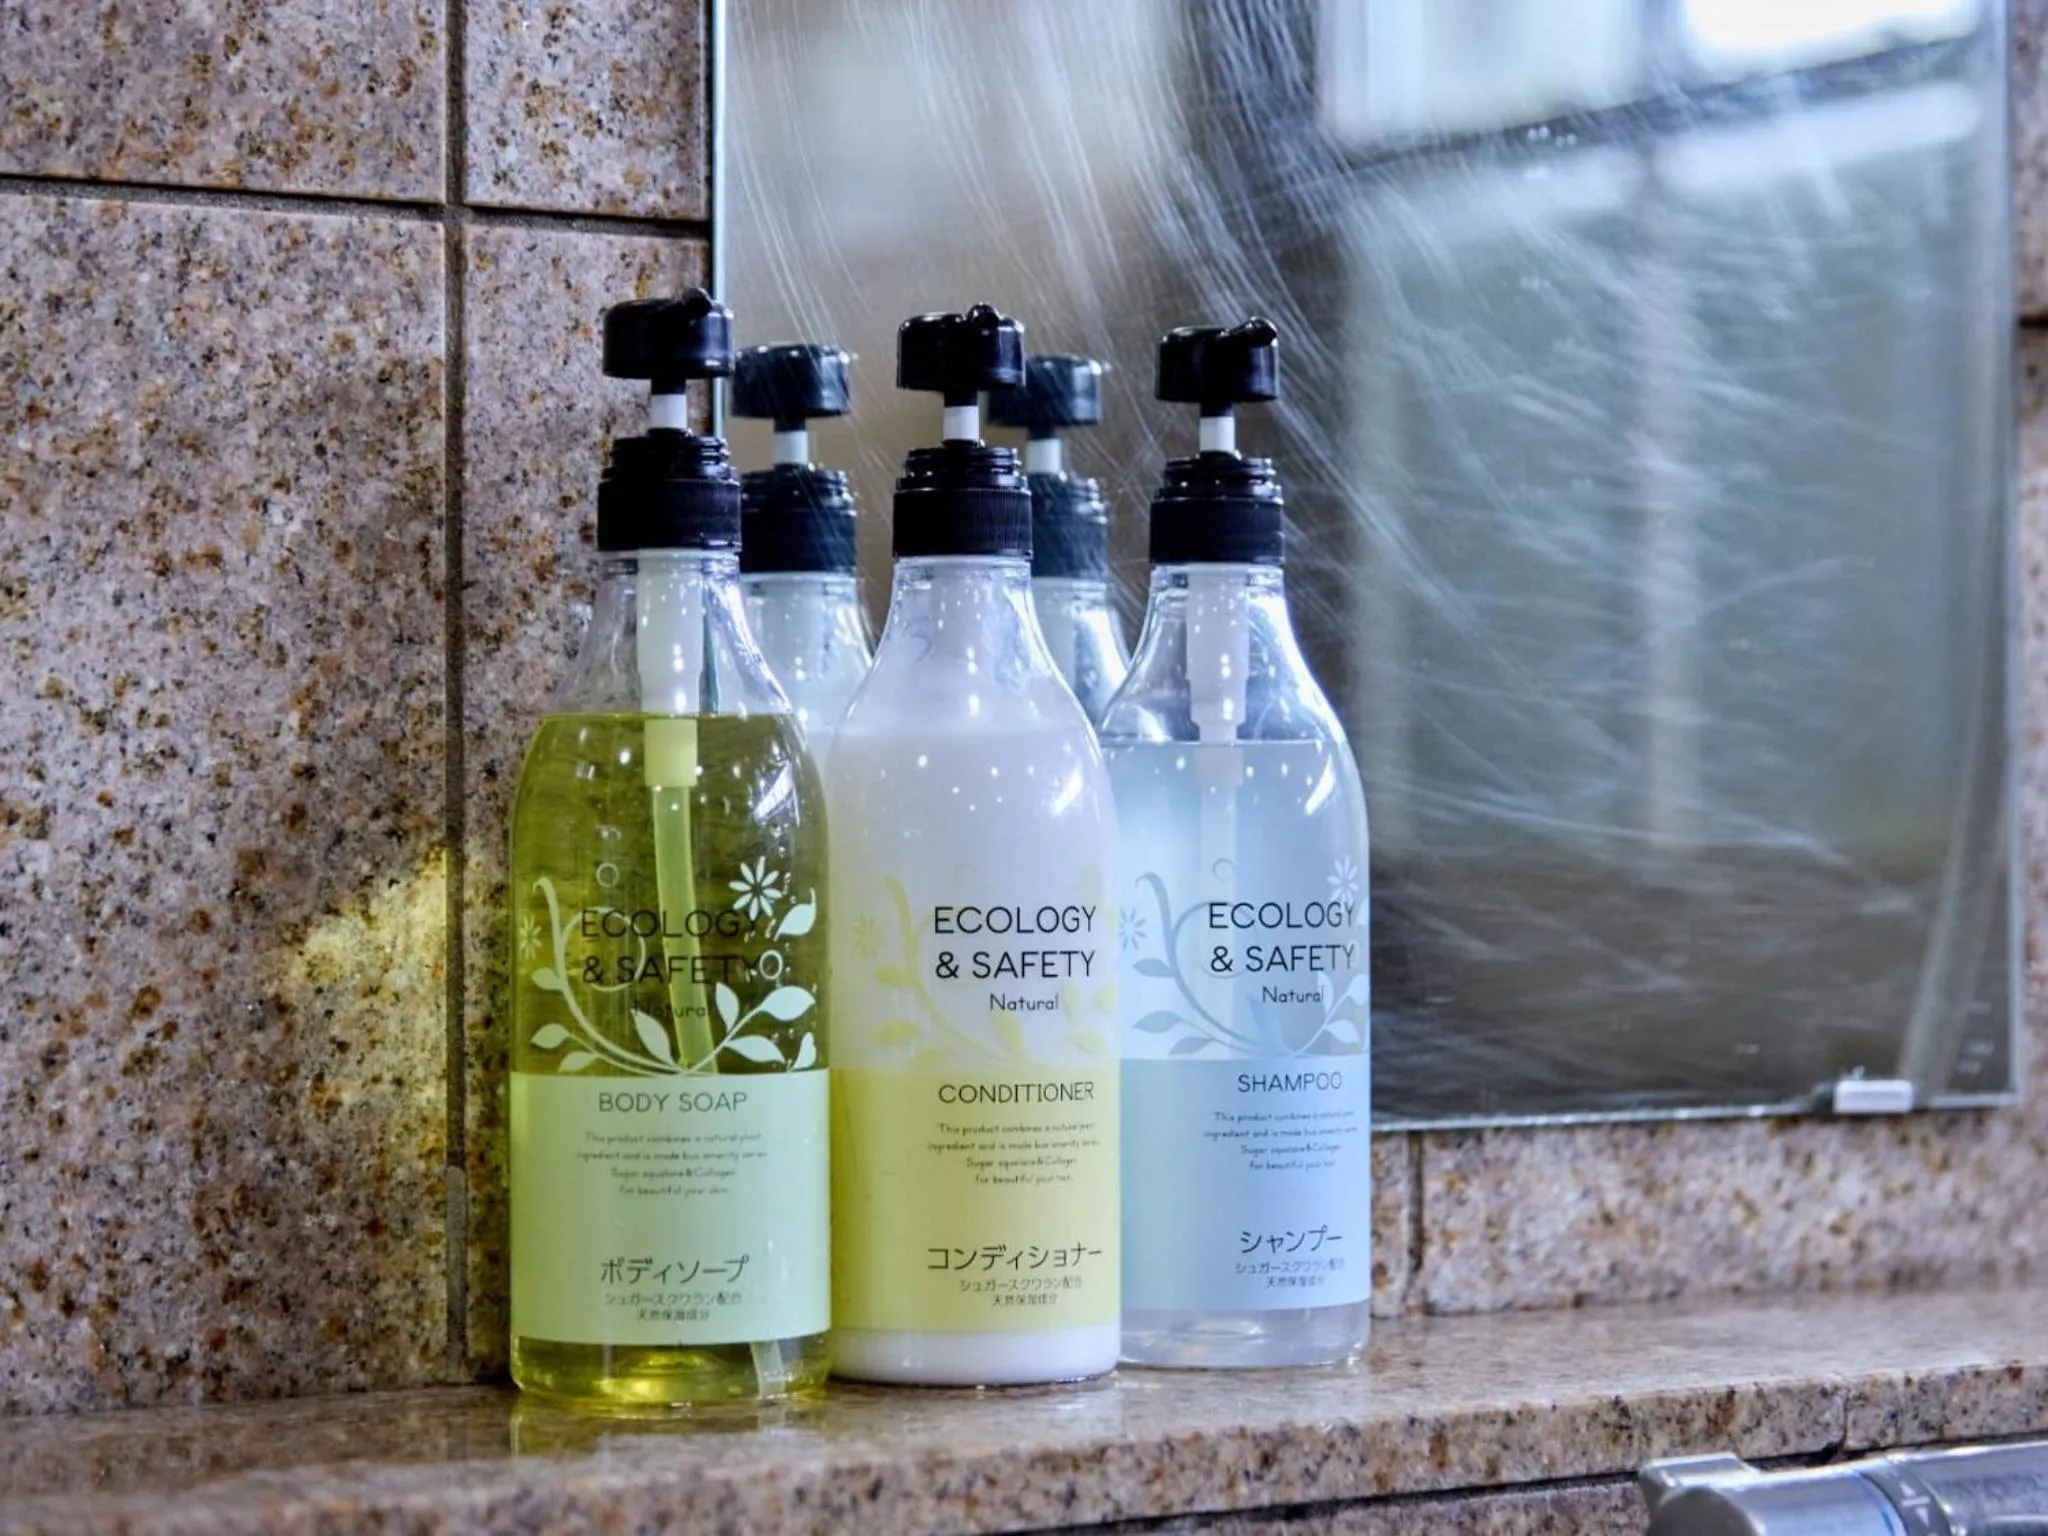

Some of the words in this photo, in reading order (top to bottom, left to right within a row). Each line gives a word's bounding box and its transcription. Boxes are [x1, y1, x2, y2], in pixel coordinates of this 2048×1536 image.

[582, 909, 757, 937] ECOLOGY
[934, 906, 1096, 934] ECOLOGY
[1208, 901, 1356, 929] ECOLOGY
[583, 956, 604, 984] &
[617, 955, 761, 984] SAFETY
[935, 951, 959, 979] &
[972, 950, 1095, 979] SAFETY
[1210, 945, 1234, 972] &
[1245, 943, 1355, 972] SAFETY
[989, 993, 1059, 1011] Natural
[1262, 985, 1324, 1003] Natural
[634, 1000, 708, 1018] Natura
[938, 1081, 1095, 1104] CONDITIONER
[1237, 1071, 1343, 1092] SHAMPOO
[598, 1092, 670, 1113] BODY
[678, 1091, 749, 1112] SOAP
[1240, 1224, 1344, 1254] シャンプー
[600, 1253, 750, 1285] ボディソープ
[927, 1242, 1103, 1271] コンディショナー
